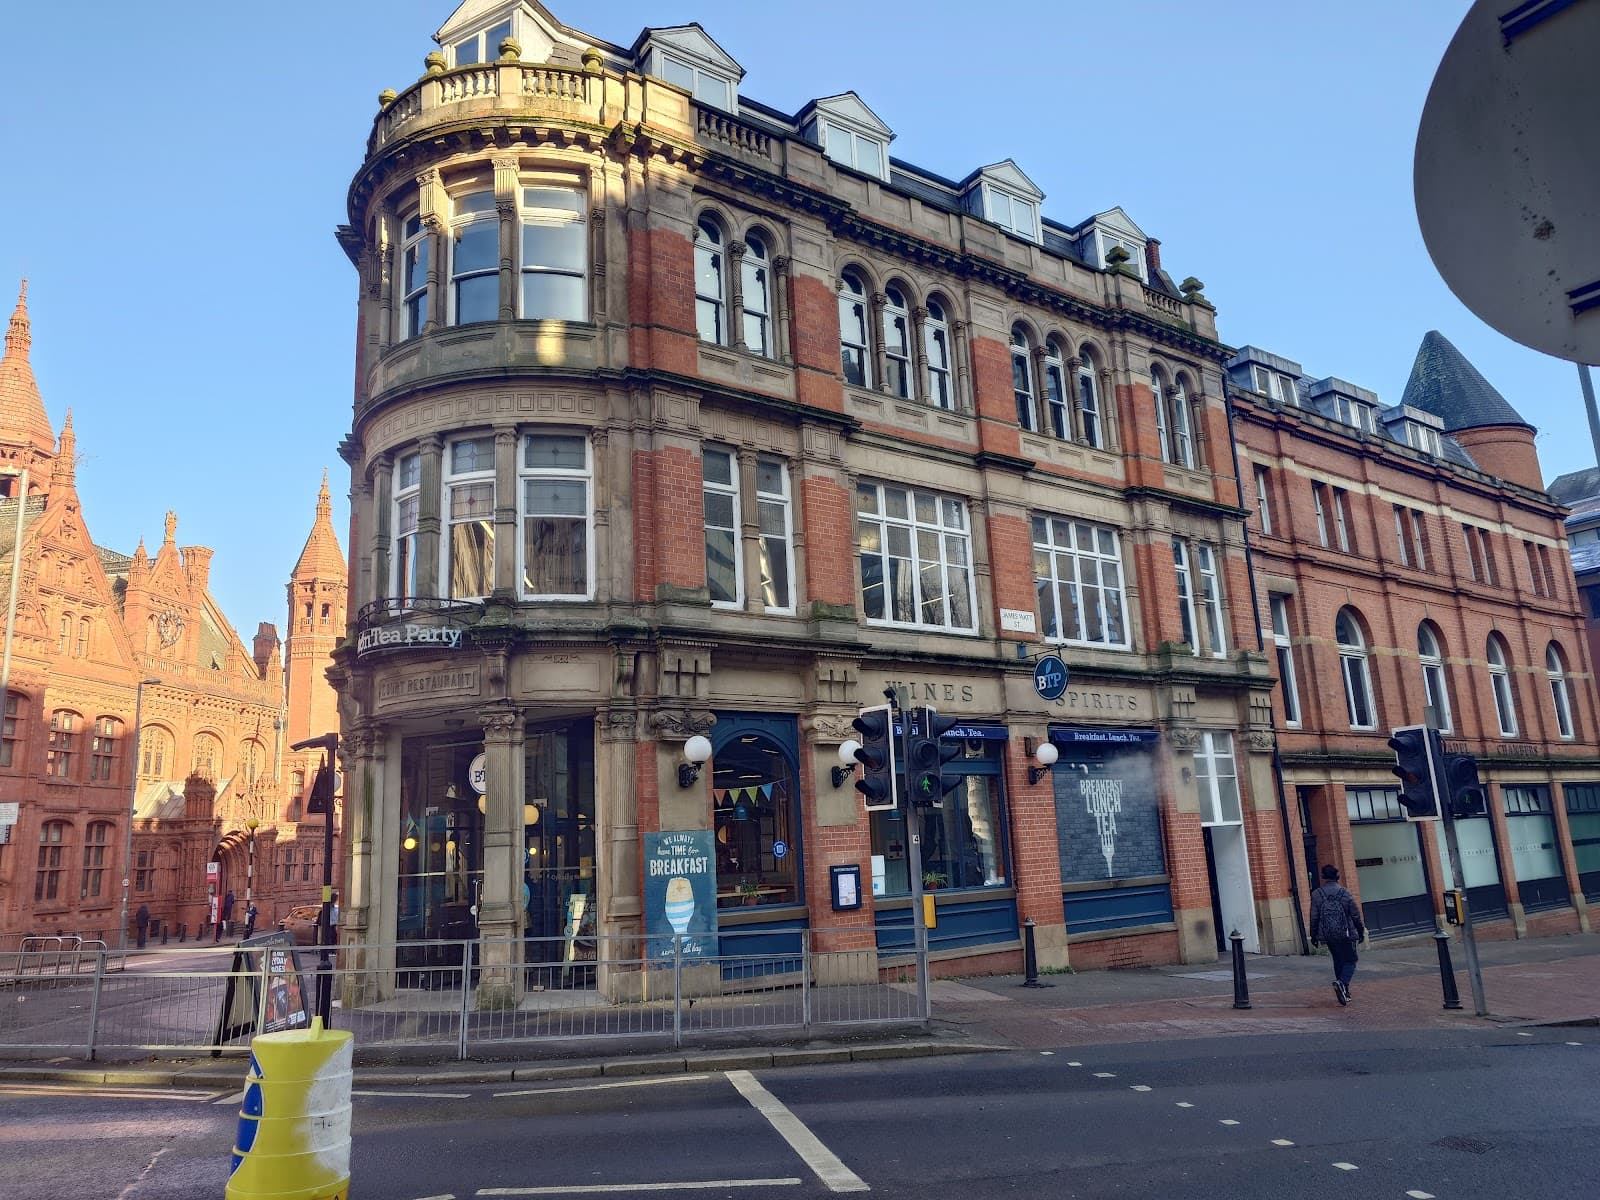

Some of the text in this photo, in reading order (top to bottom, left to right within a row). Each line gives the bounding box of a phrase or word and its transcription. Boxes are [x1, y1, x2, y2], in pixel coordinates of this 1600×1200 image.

[371, 627, 402, 646] Tea
[404, 624, 461, 647] Party
[407, 672, 472, 693] RESTAURANT
[1037, 673, 1062, 691] BTP
[968, 727, 985, 738] Tea.
[1074, 731, 1108, 742] Breakfast.
[1496, 743, 1538, 757] CHAMBERS
[474, 770, 486, 783] BT
[1080, 779, 1123, 796] BREAKFAST
[1086, 792, 1121, 814] LUNCH
[1094, 812, 1118, 836] TEA
[663, 834, 694, 846] WE ALWAYS
[671, 845, 687, 856] TIME
[650, 856, 708, 877] BREAKFAST
